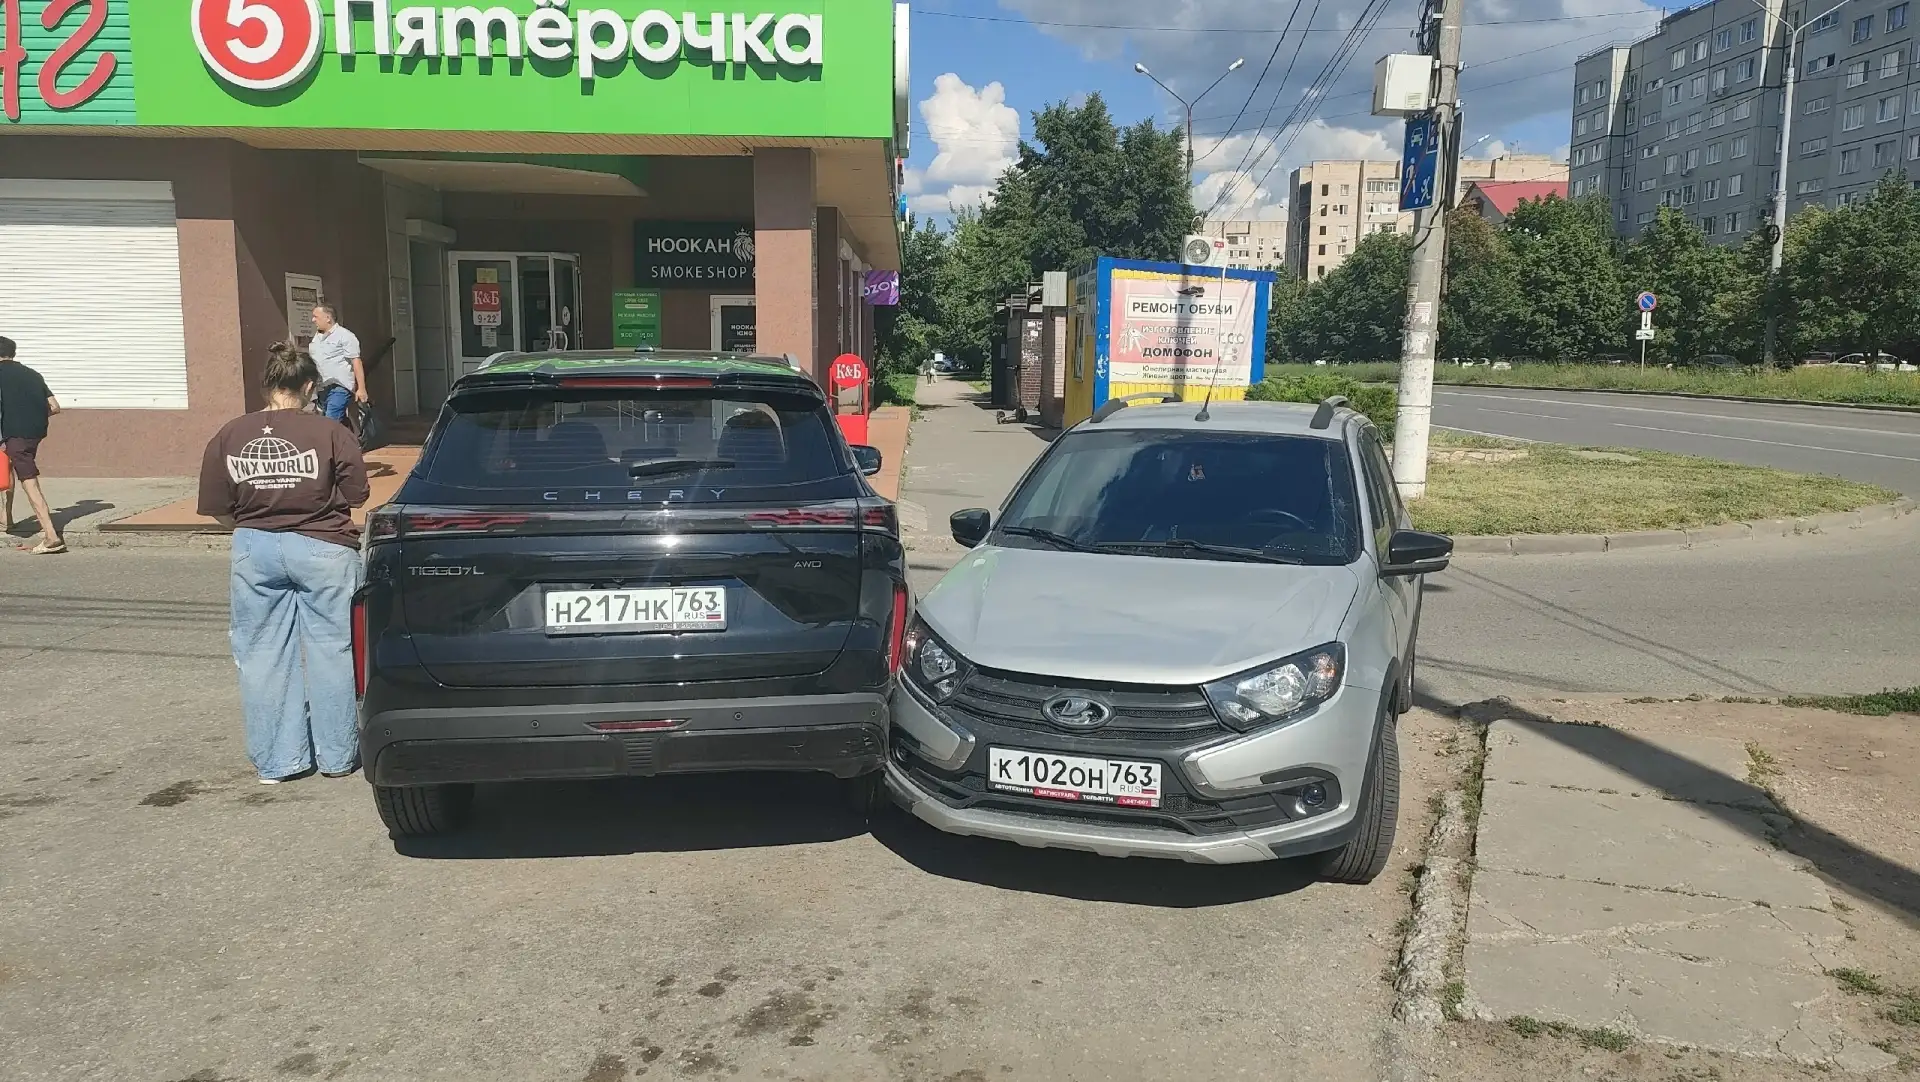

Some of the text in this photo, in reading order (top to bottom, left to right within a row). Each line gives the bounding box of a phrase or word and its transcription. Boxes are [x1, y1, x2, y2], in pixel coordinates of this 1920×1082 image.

[226, 0, 284, 64] 5
[334, 0, 823, 79] Пятёрочка
[648, 238, 730, 253] HOOKAH
[651, 266, 703, 278] SMOKE
[707, 266, 747, 278] SHOP
[864, 279, 898, 296] OZON
[473, 290, 499, 305] К&Б
[1132, 302, 1232, 315] РЕМОНТ ОБУВИ
[1142, 326, 1215, 335] ИЗГОТОВЛЕНИЕ
[1158, 336, 1197, 344] КЛЮЧЕЙ
[1143, 348, 1213, 358] ДОМОФОН
[836, 364, 862, 379] К&Б
[231, 454, 314, 479] YNX WORLD
[543, 489, 725, 500] CHERY
[556, 591, 718, 623] Н217НК 763
[684, 612, 705, 620] RUS
[998, 756, 1153, 789] К102ОН 763
[995, 784, 1034, 793] АВТОТЕХНИКА
[1082, 794, 1114, 803] ТОЛЬЯТТИ
[1119, 785, 1141, 793] RUS
